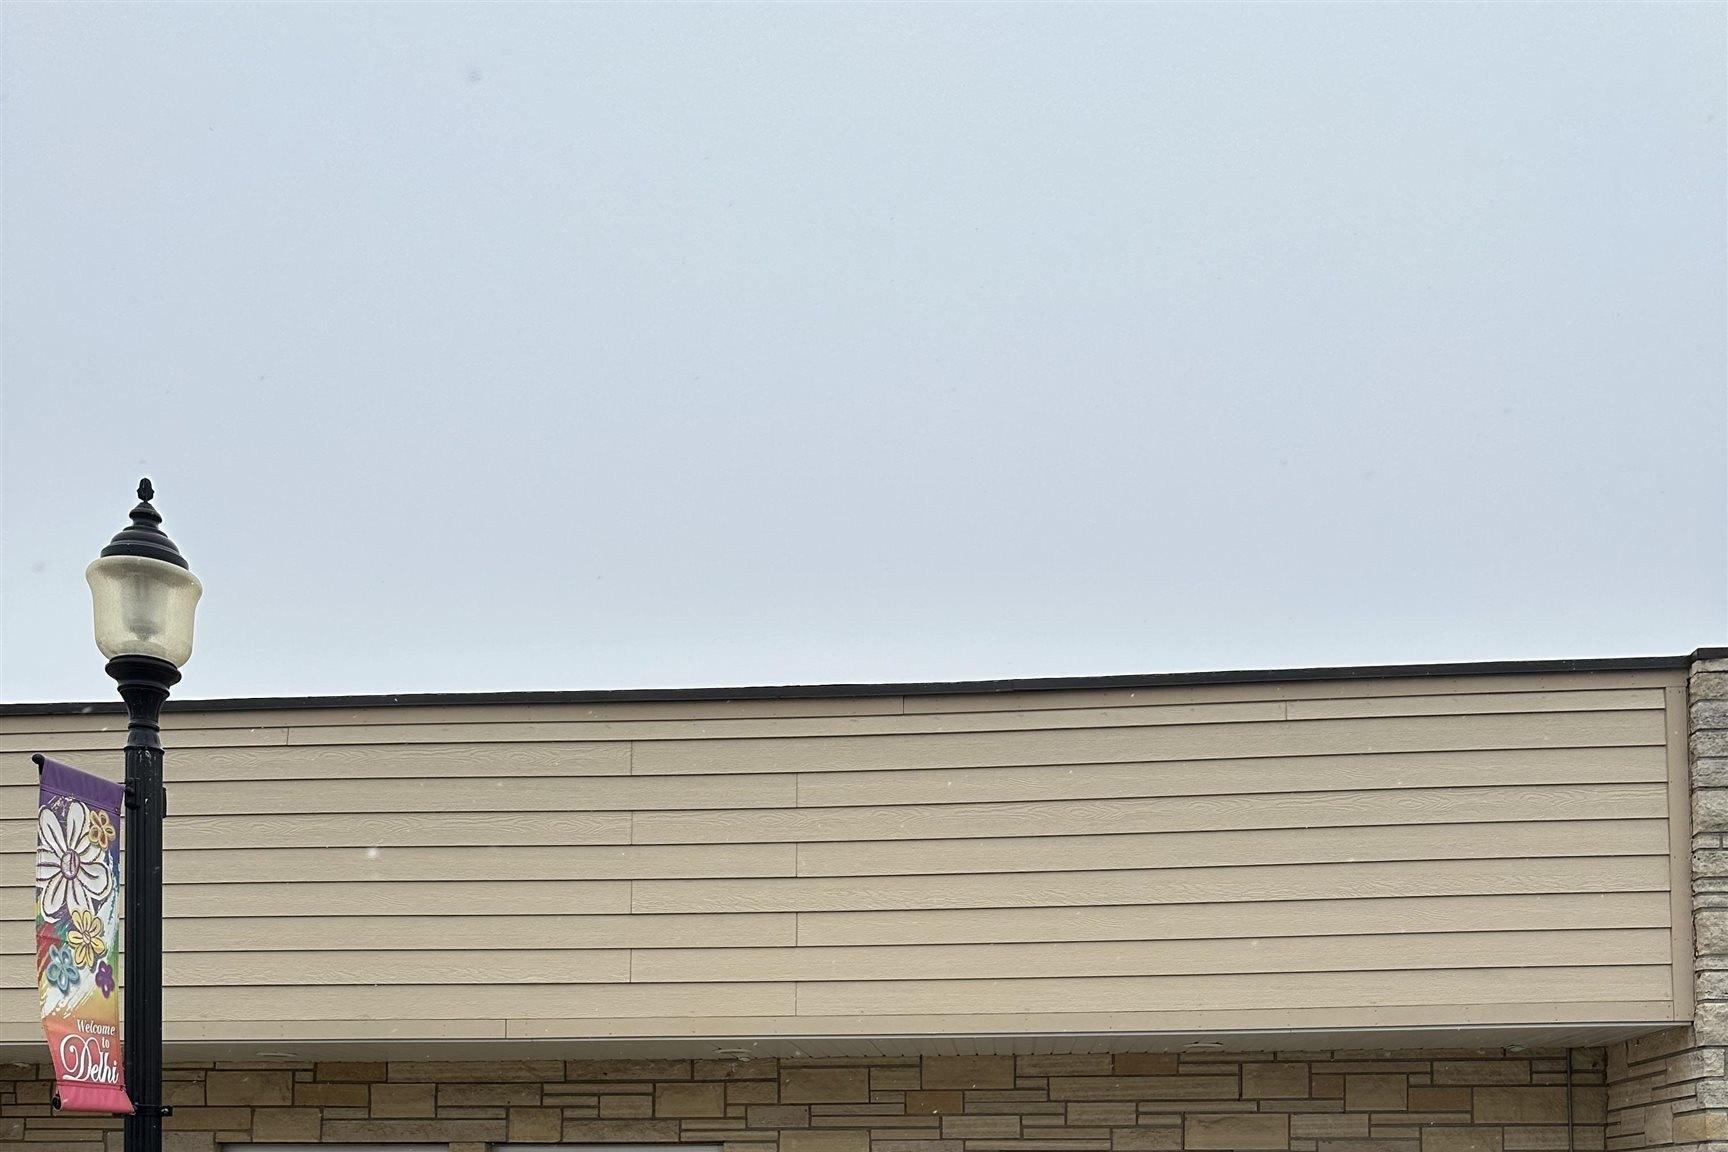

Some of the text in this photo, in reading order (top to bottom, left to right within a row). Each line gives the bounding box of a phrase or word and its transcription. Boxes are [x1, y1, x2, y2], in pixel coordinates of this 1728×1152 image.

[77, 1019, 116, 1035] Welcome
[101, 1037, 110, 1048] to
[60, 1034, 119, 1083] Delhi
